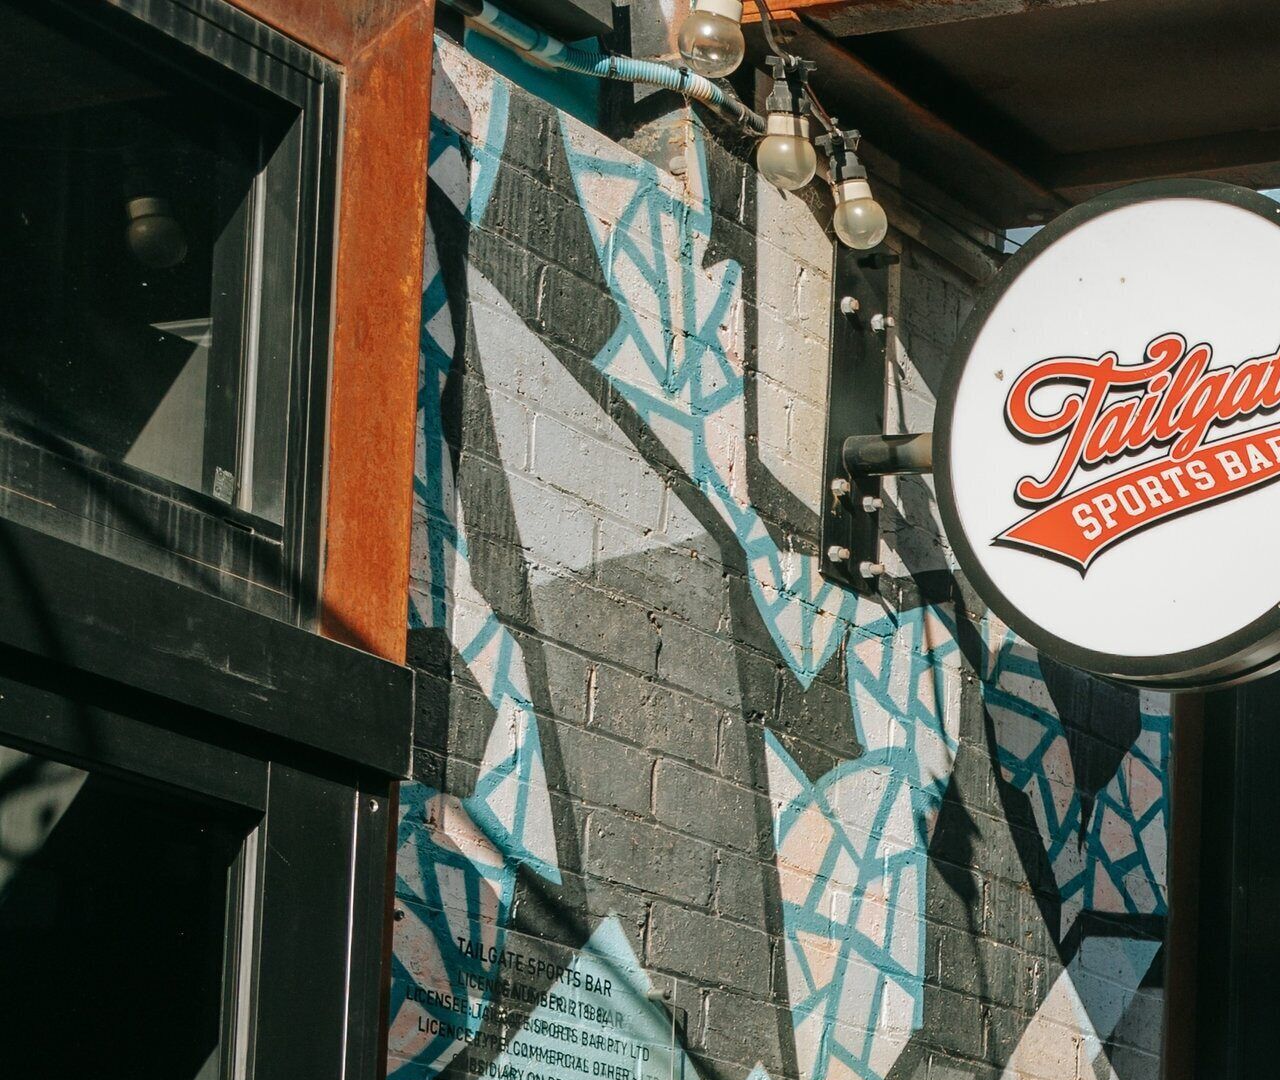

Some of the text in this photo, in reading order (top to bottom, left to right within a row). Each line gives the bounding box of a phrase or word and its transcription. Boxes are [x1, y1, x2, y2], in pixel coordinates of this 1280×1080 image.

[1072, 457, 1212, 541] SPORTS
[458, 937, 612, 997] TAILGATE SPORTS BAR
[406, 984, 472, 1016] LICENSEE:
[534, 1018, 578, 1043] SPORTS
[582, 1031, 604, 1050] BAR
[607, 1037, 628, 1056] PTY
[630, 1043, 650, 1062] LTD
[418, 1015, 472, 1044] LICENCE
[514, 1041, 590, 1073] COMMERCIAL
